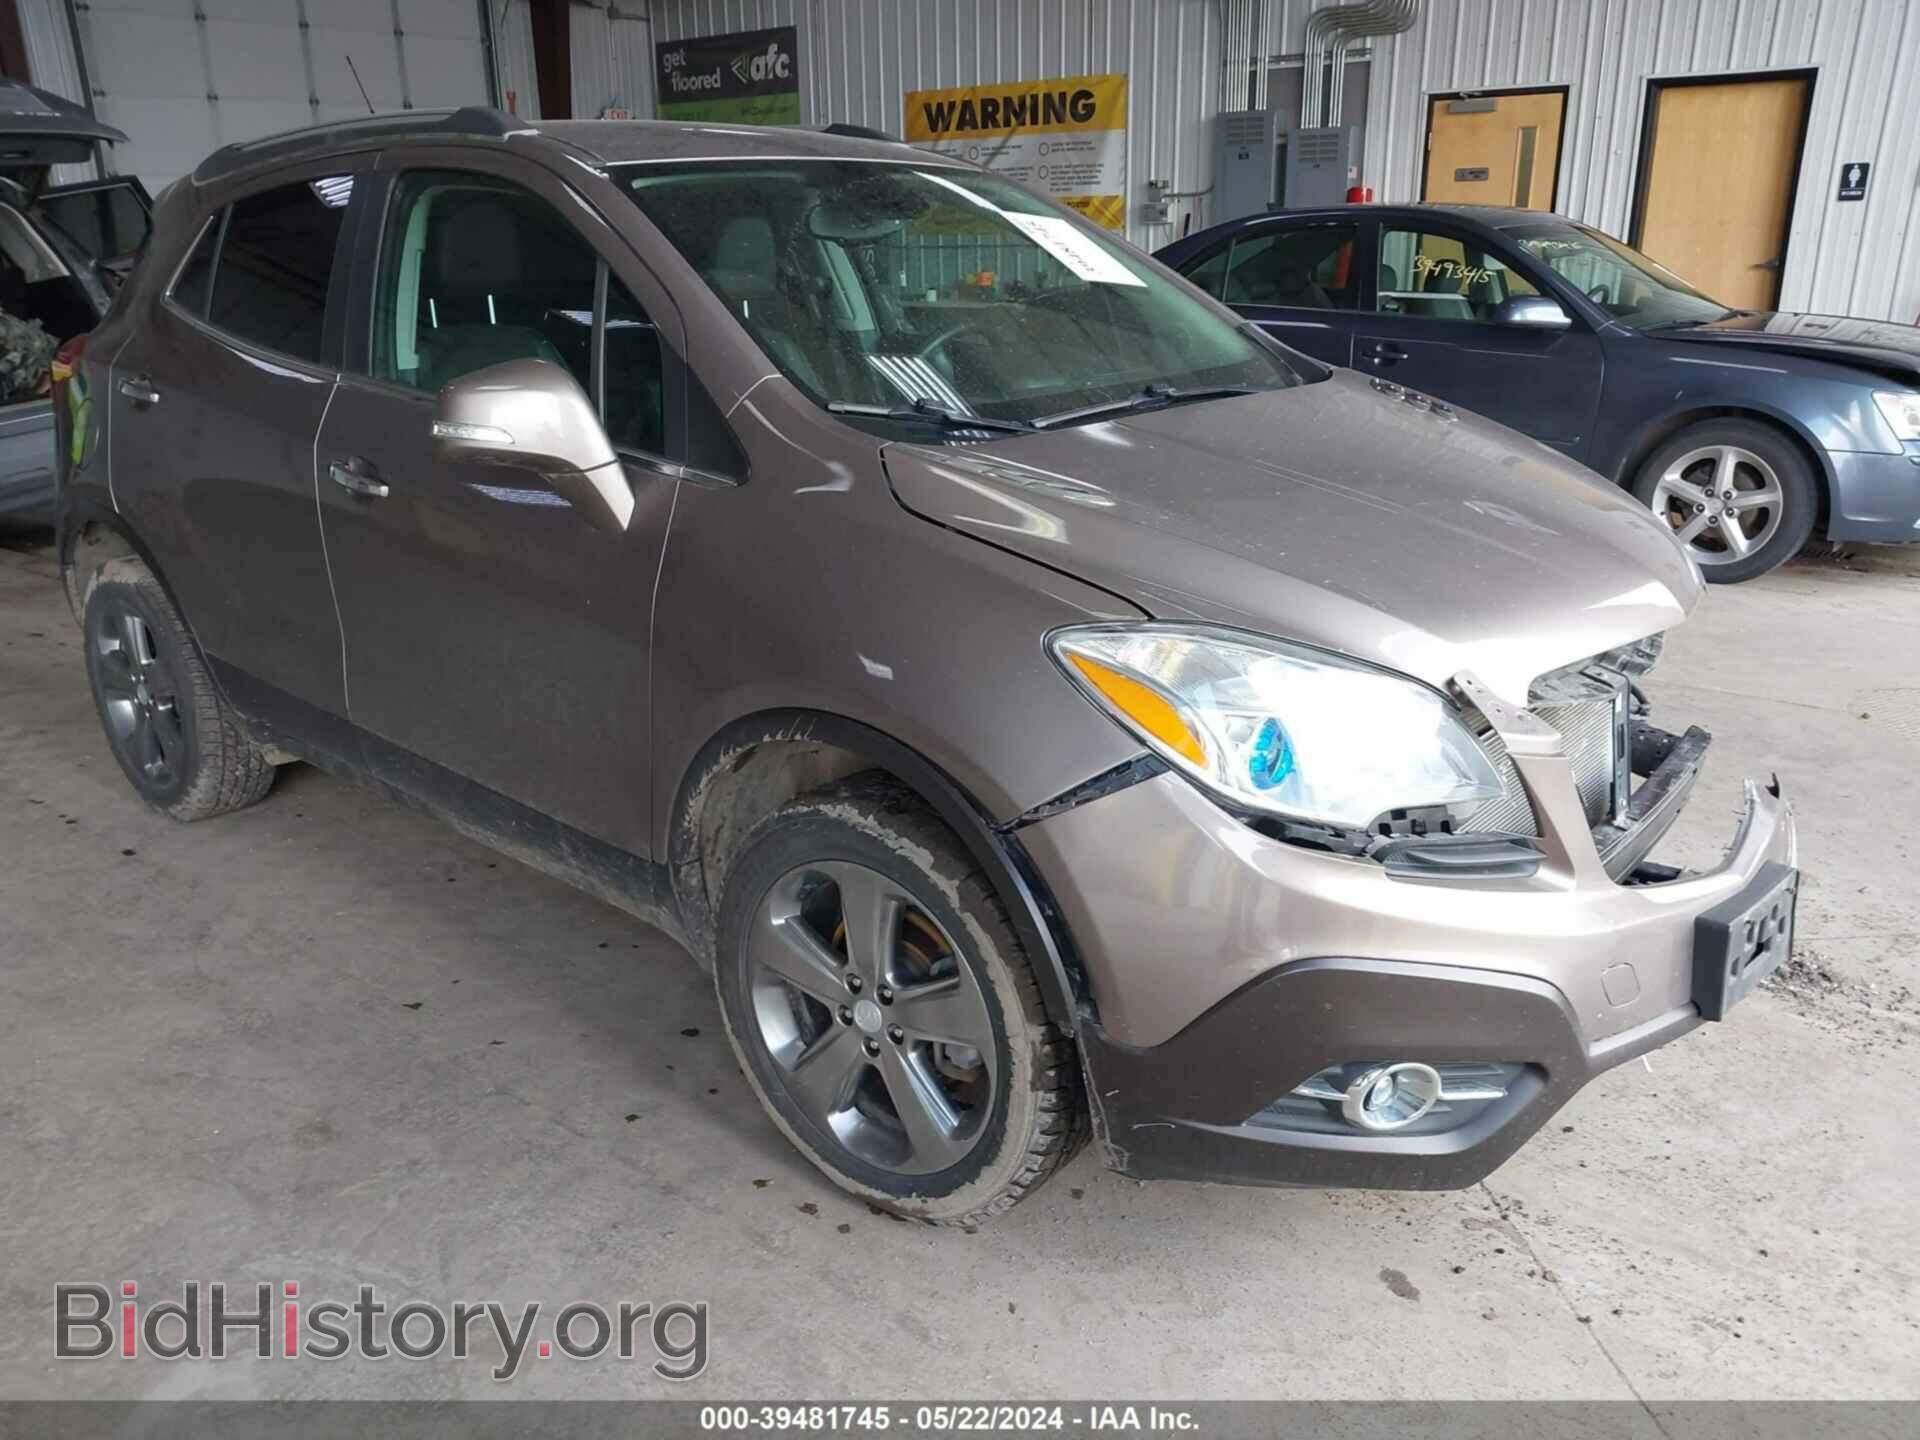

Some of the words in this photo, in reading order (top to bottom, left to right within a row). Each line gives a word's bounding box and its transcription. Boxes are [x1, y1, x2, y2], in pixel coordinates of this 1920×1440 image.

[663, 47, 687, 73] get
[750, 42, 791, 81] afc
[671, 67, 721, 92] floored
[923, 89, 1097, 133] WARNING
[1409, 254, 1497, 285] 39493415
